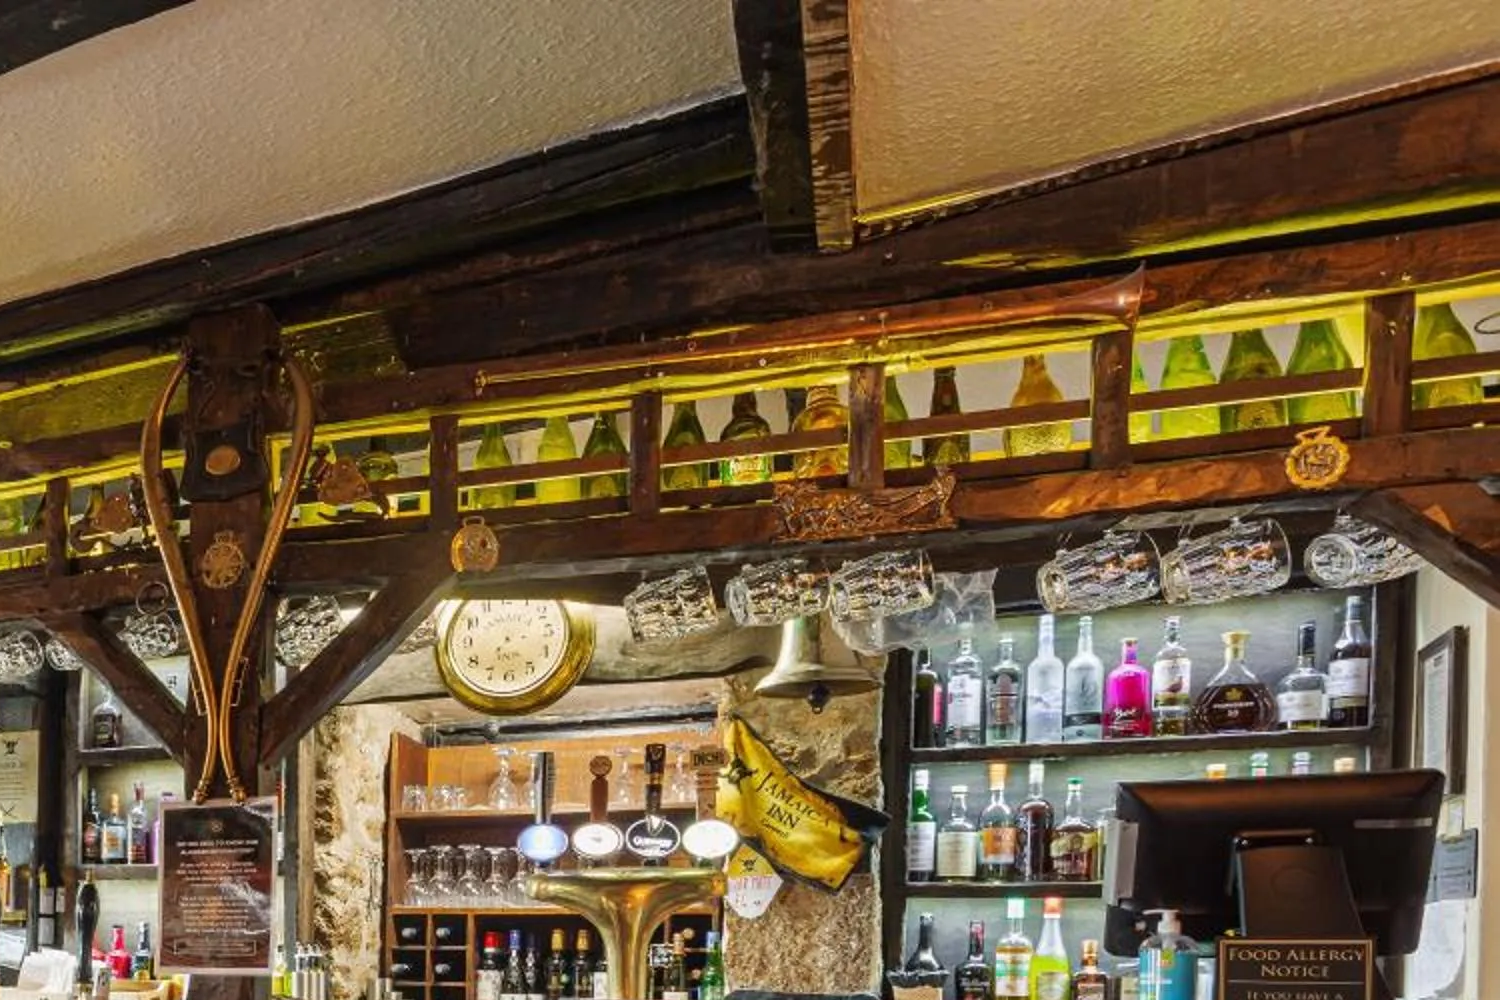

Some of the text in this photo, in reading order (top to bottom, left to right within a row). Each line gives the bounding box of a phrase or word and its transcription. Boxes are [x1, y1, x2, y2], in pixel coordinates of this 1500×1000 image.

[766, 803, 801, 829] INN
[1229, 948, 1363, 961] FOOD ALLERGY
[1261, 965, 1330, 978] NOTICE
[1263, 991, 1291, 1000] YOU
[1296, 991, 1328, 1000] HAVE
